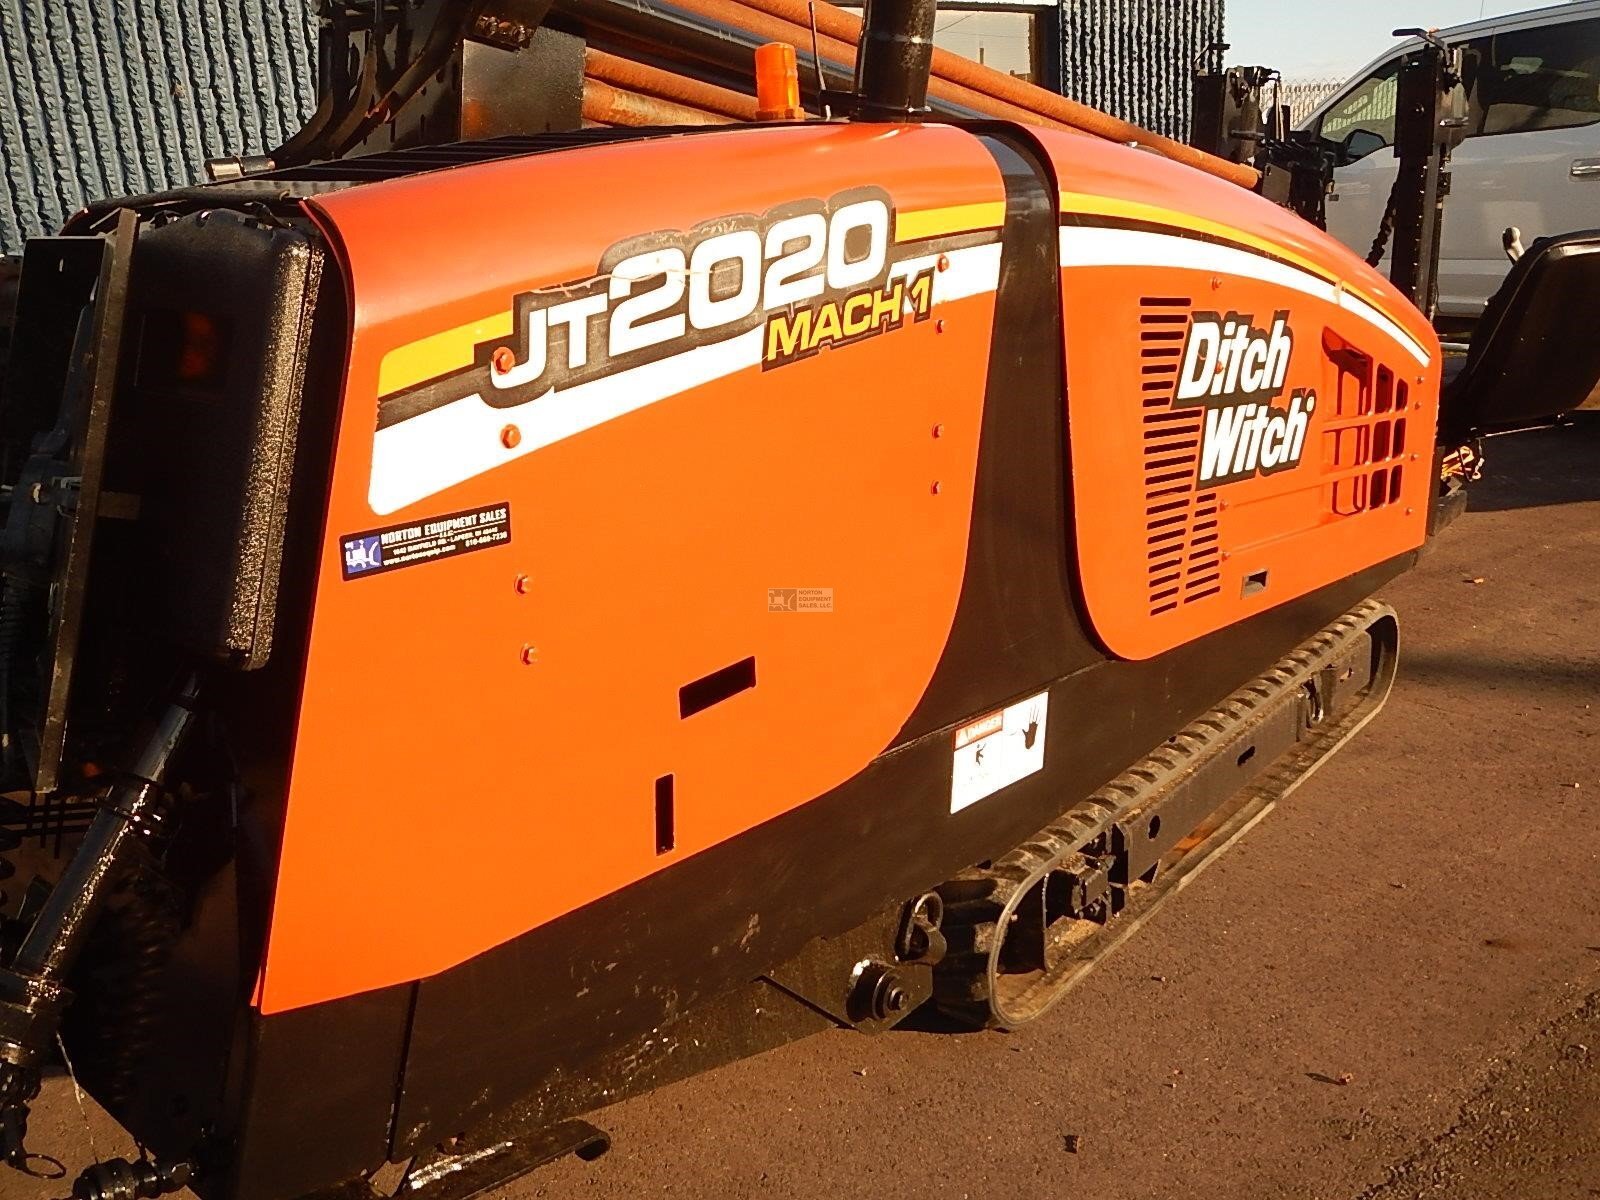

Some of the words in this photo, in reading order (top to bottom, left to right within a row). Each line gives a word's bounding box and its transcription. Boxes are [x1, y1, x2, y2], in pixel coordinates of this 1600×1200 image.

[491, 199, 888, 390] JT2020
[767, 284, 902, 361] MACH
[911, 277, 931, 314] 1
[1177, 319, 1291, 399] Ditch
[1200, 397, 1309, 481] Witch
[381, 526, 421, 545] NORTON
[425, 514, 477, 535] EQUIPMENT
[479, 508, 506, 523] SALES
